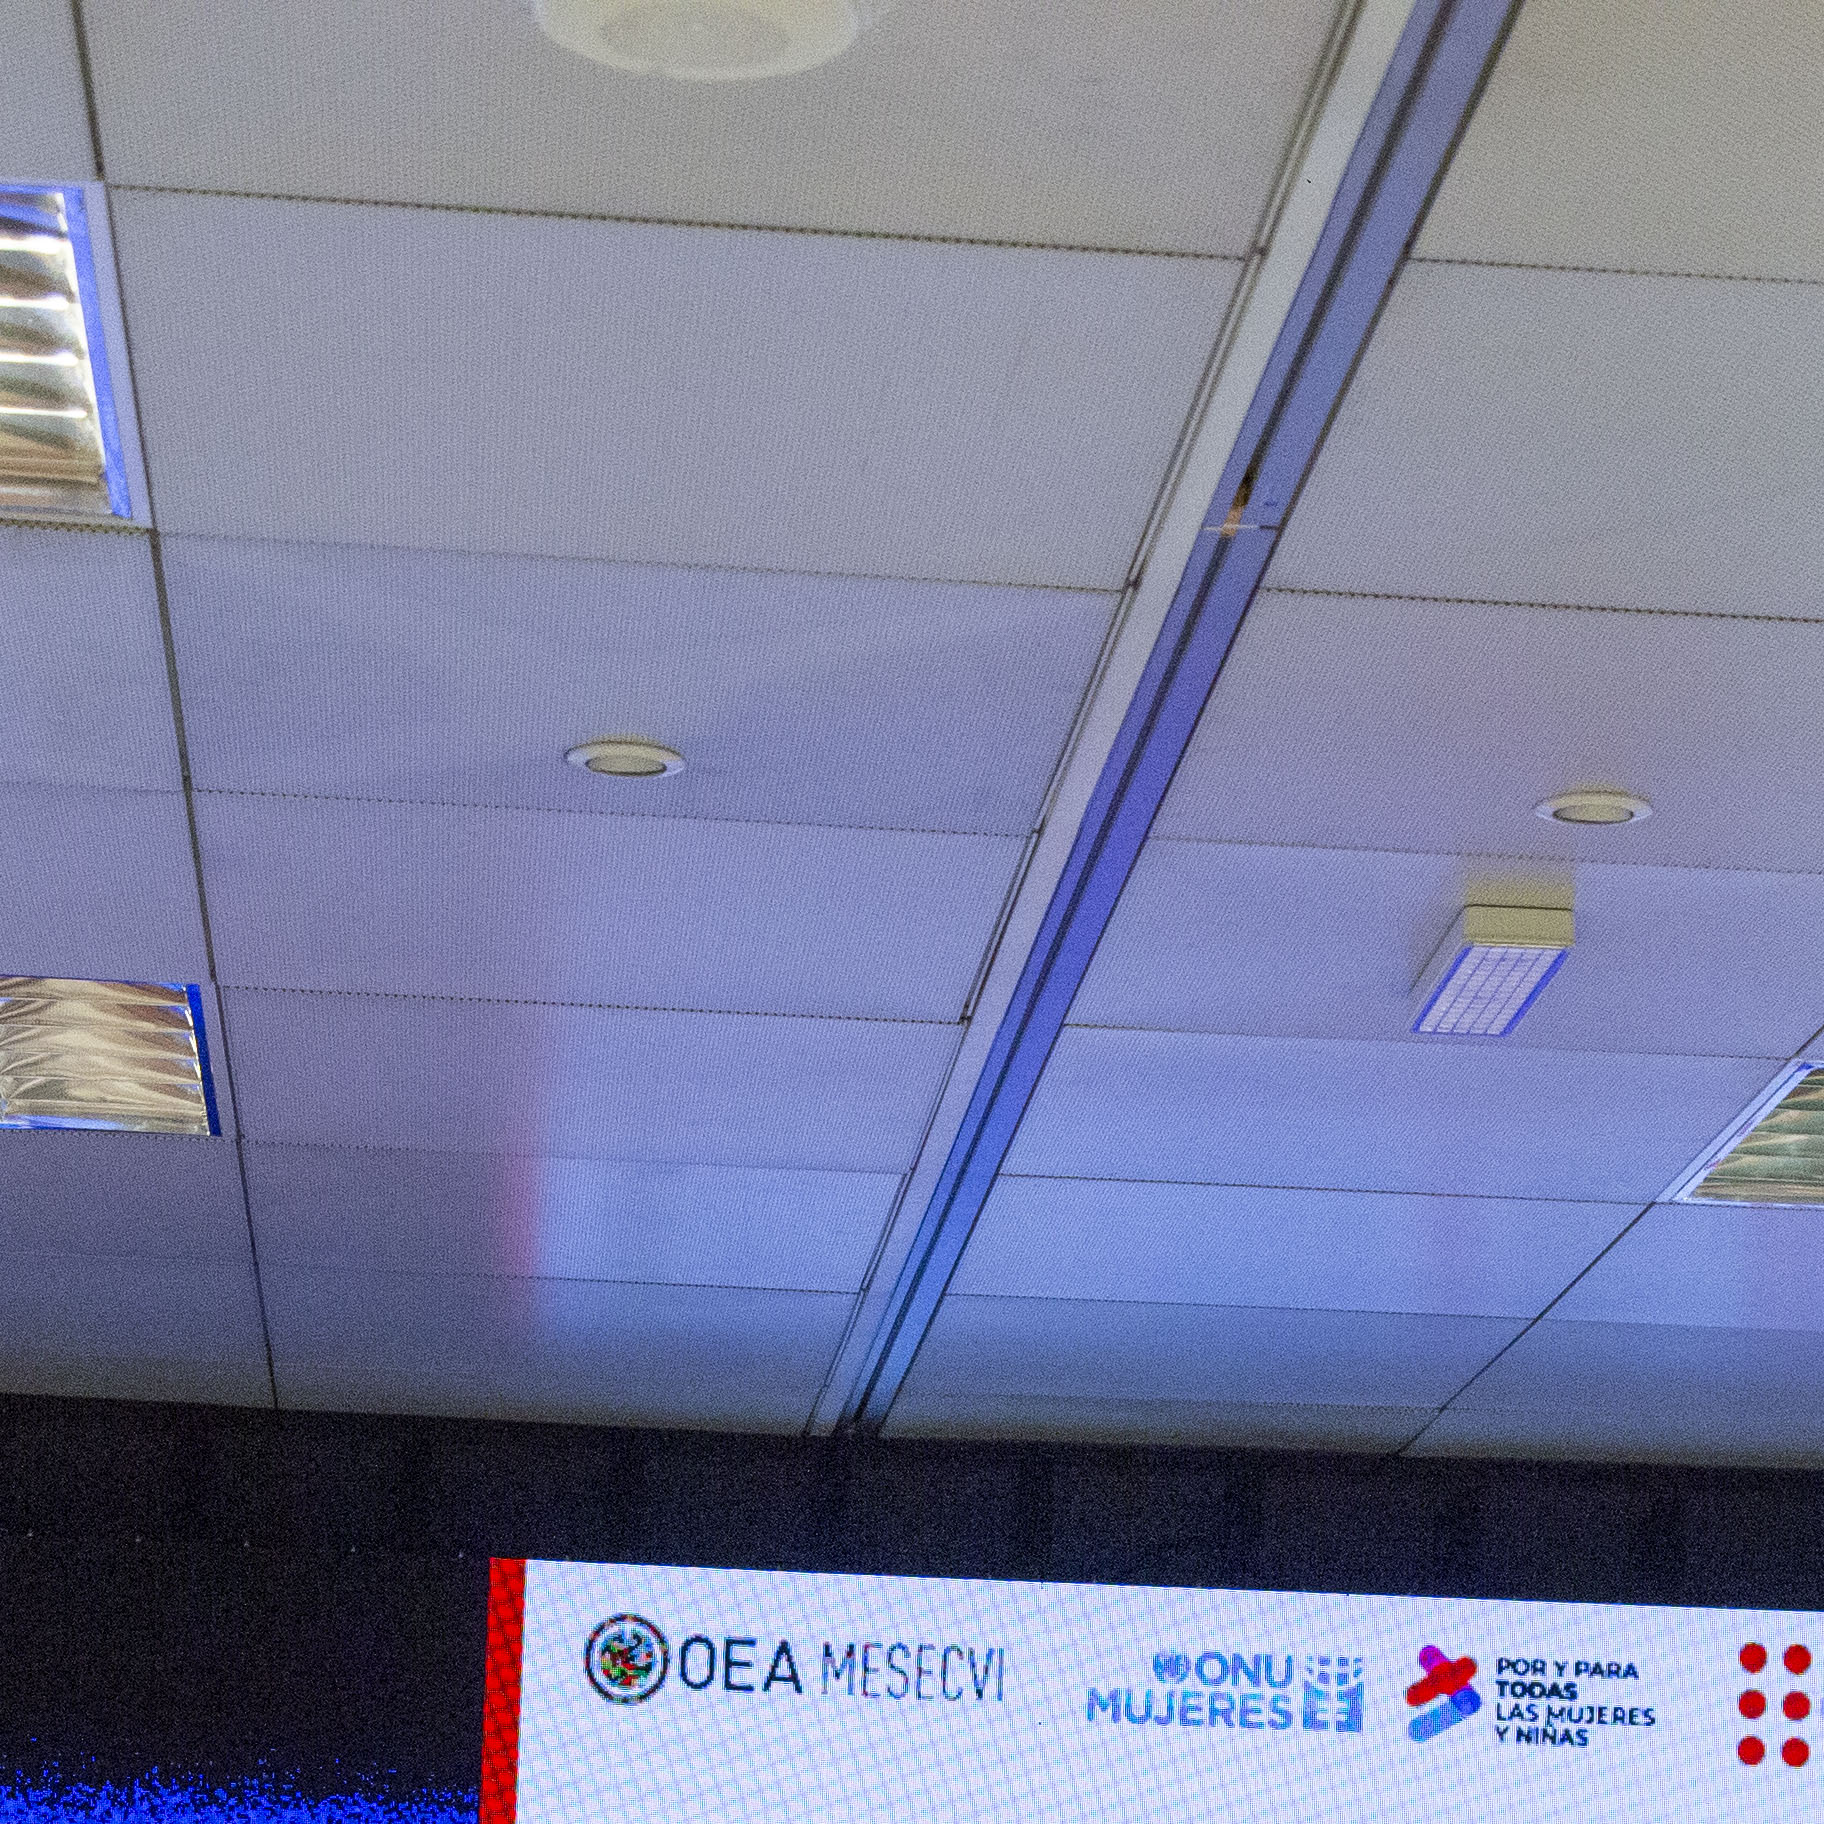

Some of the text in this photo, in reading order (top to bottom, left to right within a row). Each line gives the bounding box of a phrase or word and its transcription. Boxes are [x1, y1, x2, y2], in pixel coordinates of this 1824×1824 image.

[679, 1634, 1005, 1702] OEA MESECVI
[1194, 1651, 1294, 1689] ONU
[1496, 1657, 1639, 1680] POR Y PARA
[1496, 1681, 1578, 1701] TODAS
[1087, 1686, 1293, 1729] MUJERES
[1496, 1703, 1656, 1727] LAS MUJERES
[1495, 1723, 1590, 1747] Y NIÑAS
